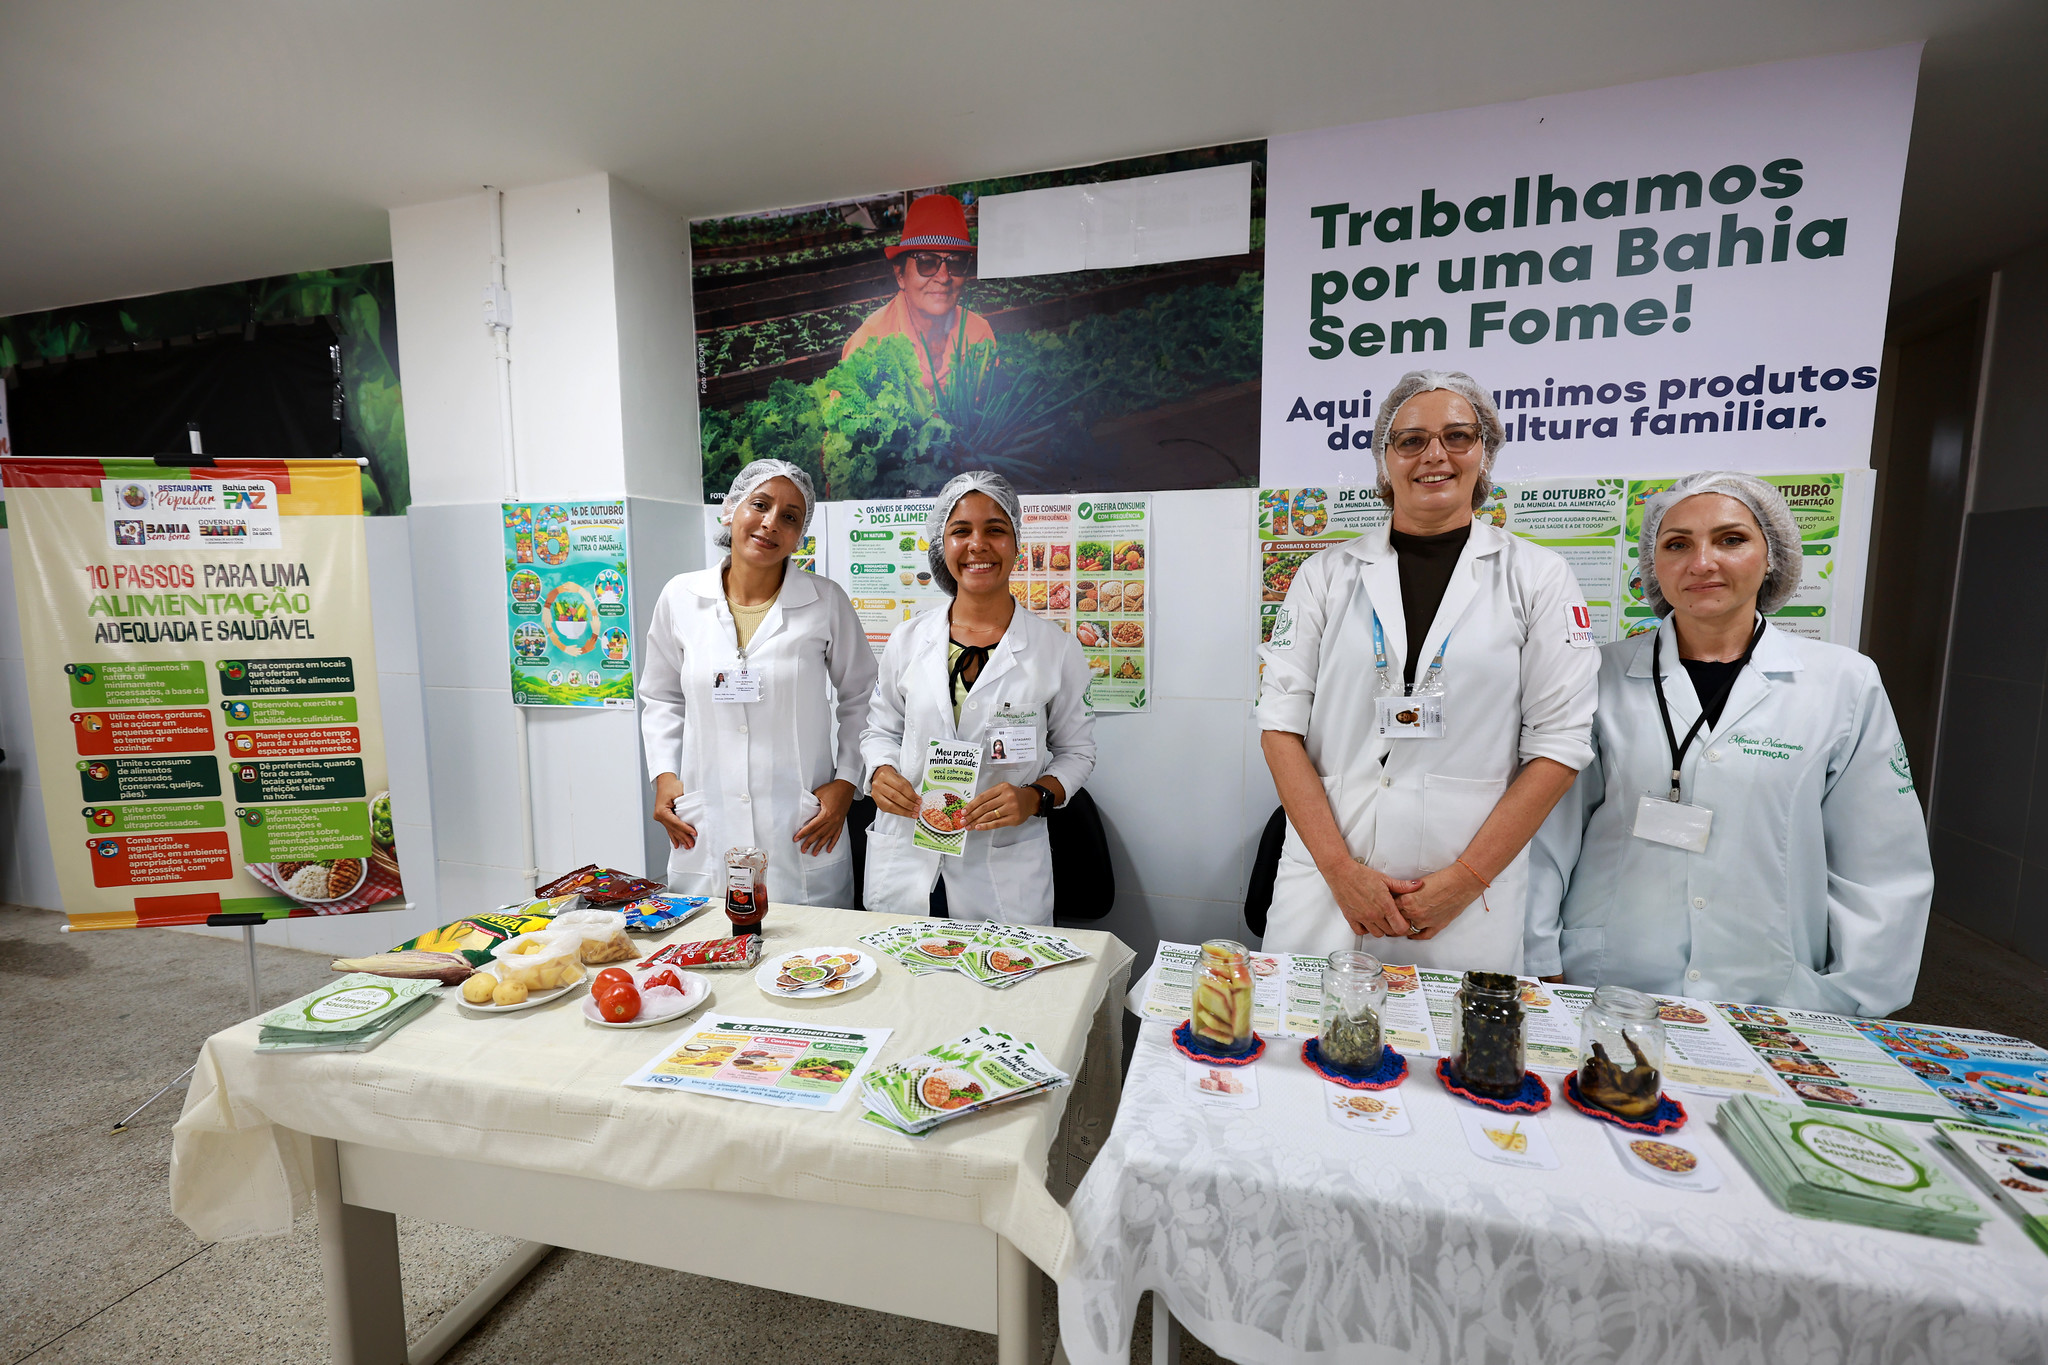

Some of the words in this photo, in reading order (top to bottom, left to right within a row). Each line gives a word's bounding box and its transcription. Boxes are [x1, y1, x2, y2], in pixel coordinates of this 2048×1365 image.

[1310, 156, 1805, 250] Trabalhamos
[1310, 257, 1419, 320] por
[1436, 244, 1593, 294] uma
[1615, 205, 1848, 278] Bahia
[1307, 314, 1448, 360] Sem
[1468, 283, 1693, 348] Fome!
[1286, 389, 1371, 428] Aqui
[1658, 364, 1878, 409] produtos
[1327, 423, 1374, 451] da
[1630, 398, 1827, 437] familiar.
[248, 484, 265, 492] pela
[1340, 490, 1355, 501] DE
[1359, 490, 1378, 500] OU
[1521, 491, 1538, 501] DE
[1543, 488, 1606, 500] OUTUBRO
[155, 490, 215, 511] Popular
[223, 492, 267, 509] PAZ
[1570, 499, 1615, 507] ALIMENTAÇÃO
[571, 507, 578, 516] 16
[580, 506, 588, 516] DE
[591, 506, 623, 515] OUTUBRO
[876, 504, 894, 512] NÍVEIS
[1023, 505, 1040, 513] EVITE
[1094, 503, 1116, 511] PREFIRA
[1117, 502, 1145, 510] CONSUMIR
[1264, 488, 1328, 536] 16
[871, 514, 890, 524] DOS
[1110, 512, 1140, 520] FREQUÊNCIA
[146, 524, 190, 533] BAHIA
[200, 526, 247, 536] BAHIA
[147, 533, 166, 541] sem
[169, 533, 190, 541] fome
[505, 505, 570, 565] 16
[852, 532, 857, 540] 1
[86, 565, 109, 589] 10
[113, 564, 194, 589] PASSOS
[203, 563, 257, 587] PARA
[260, 563, 310, 587] UMA
[88, 587, 310, 619] ALIMENTAÇÃO
[1573, 606, 1590, 628] U
[95, 621, 198, 644] ADEQUADA
[201, 621, 213, 641] E
[217, 615, 314, 640] SAUDÁVEL
[130, 720, 160, 729] açúcar
[112, 728, 154, 737] pequenas
[155, 727, 208, 736] quantidades
[323, 730, 351, 738] tempo
[125, 736, 165, 744] temperar
[299, 737, 351, 746] alimentação
[1728, 735, 1759, 747] Mônica
[1762, 737, 1803, 751] Nascimento
[114, 744, 152, 752] cozinhar.
[258, 748, 287, 756] espaço
[935, 748, 951, 756] Meu
[953, 749, 974, 759] prato,
[1743, 748, 1790, 760] NUTRIÇÃO
[930, 757, 952, 765] minha
[954, 758, 978, 768] saúde:
[332, 996, 379, 1006] Alimentos
[1714, 1003, 1789, 1026] 16
[750, 1025, 785, 1033] Grupos
[787, 1027, 850, 1038] Alimentares
[1771, 1050, 1803, 1058] CASCAS
[1010, 1055, 1029, 1067] Meu
[1797, 1077, 1842, 1086] SEMENTES
[1813, 1137, 1897, 1162] Alimentos
